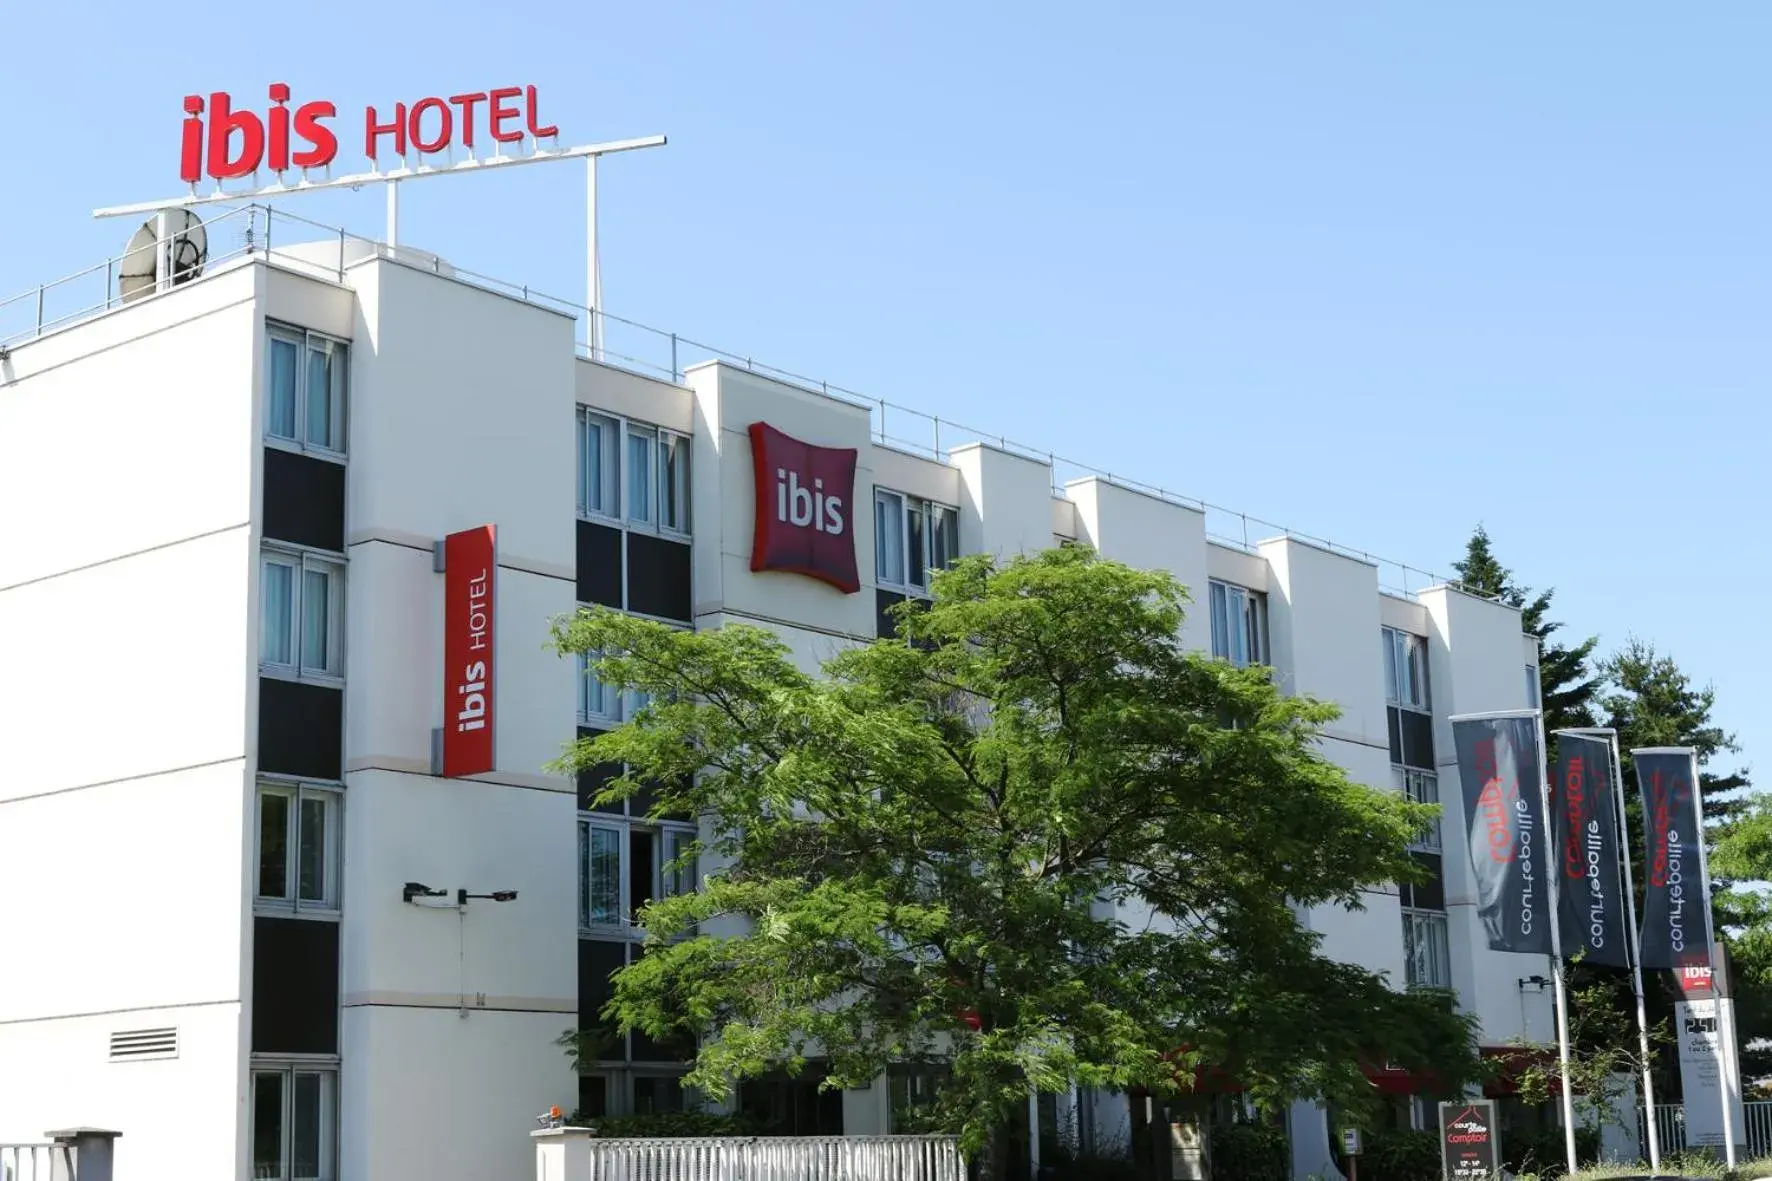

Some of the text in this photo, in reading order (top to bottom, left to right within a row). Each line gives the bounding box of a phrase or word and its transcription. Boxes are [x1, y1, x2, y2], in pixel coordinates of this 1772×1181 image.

[180, 83, 559, 183] ibis HOTEL
[777, 467, 844, 535] ibis
[458, 568, 487, 732] ibis HOTEL
